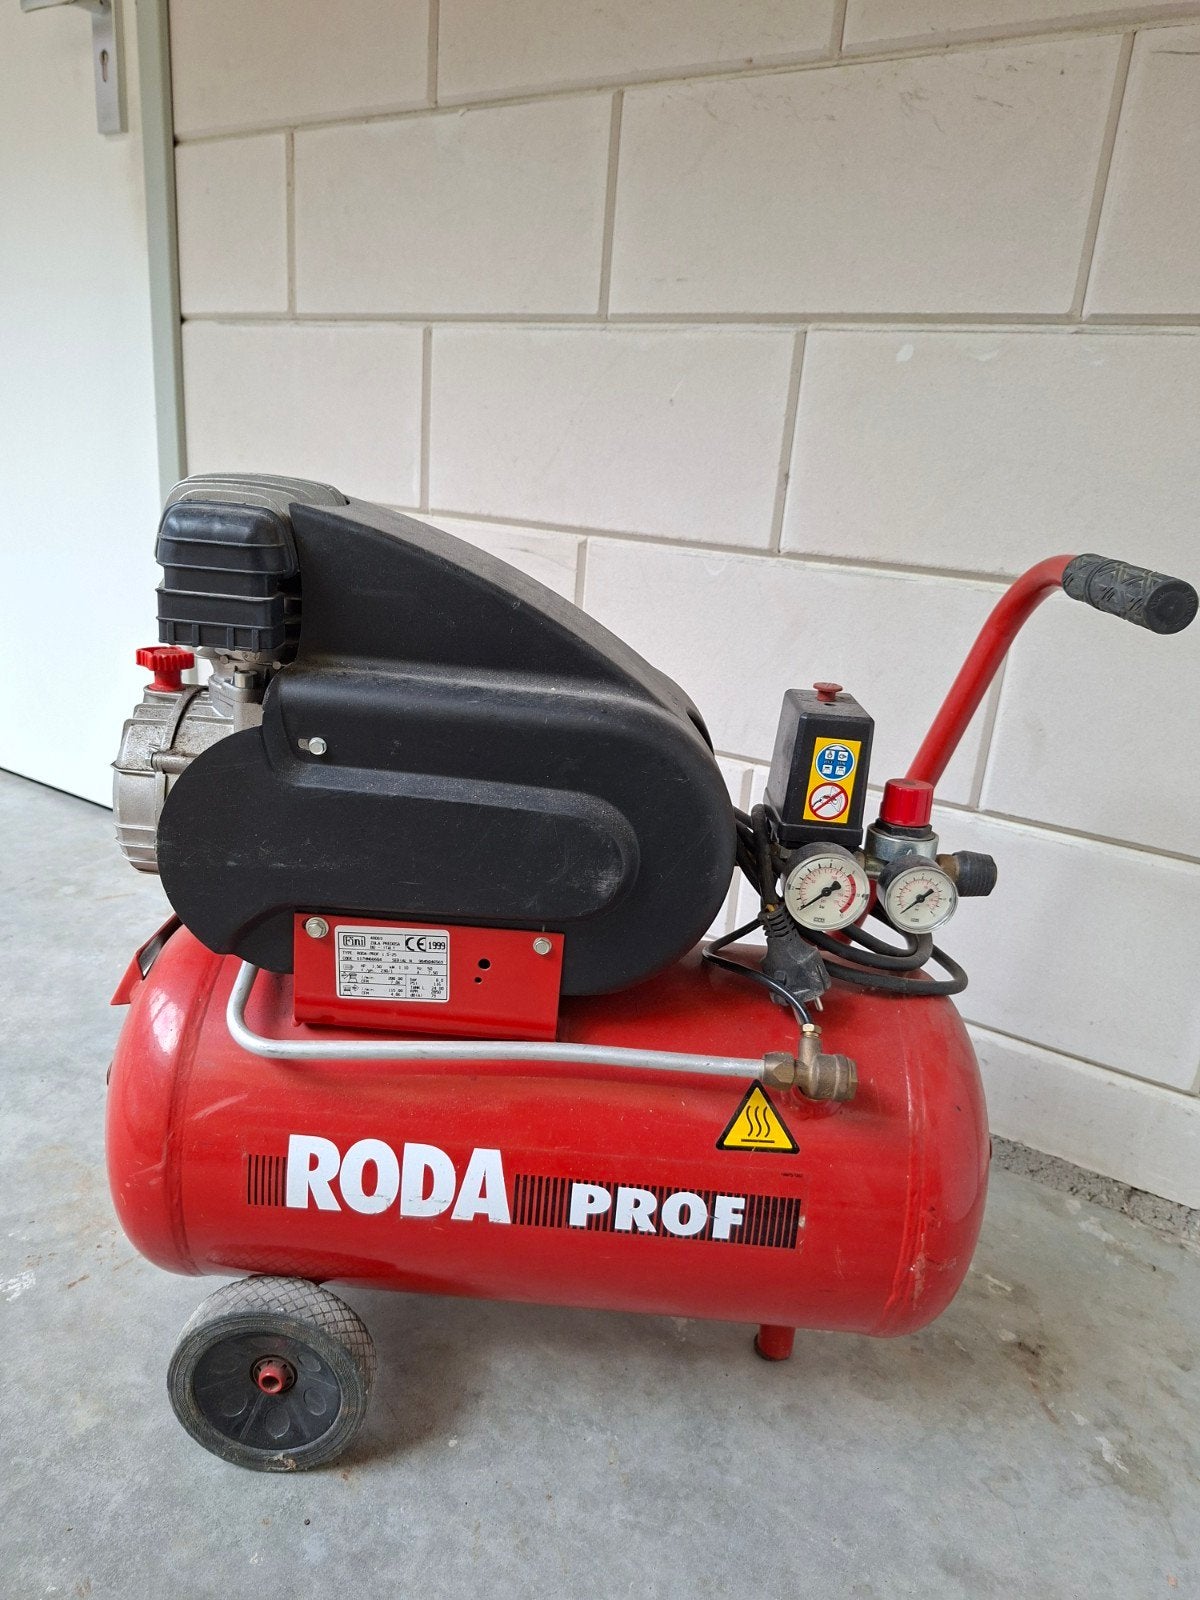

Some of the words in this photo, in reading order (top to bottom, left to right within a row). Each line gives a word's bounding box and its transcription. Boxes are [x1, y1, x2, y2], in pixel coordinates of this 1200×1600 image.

[344, 935, 365, 946] Fini
[405, 936, 427, 953] CE
[428, 941, 446, 950] 1999
[286, 1134, 512, 1225] RODA
[569, 1183, 746, 1239] PROF
